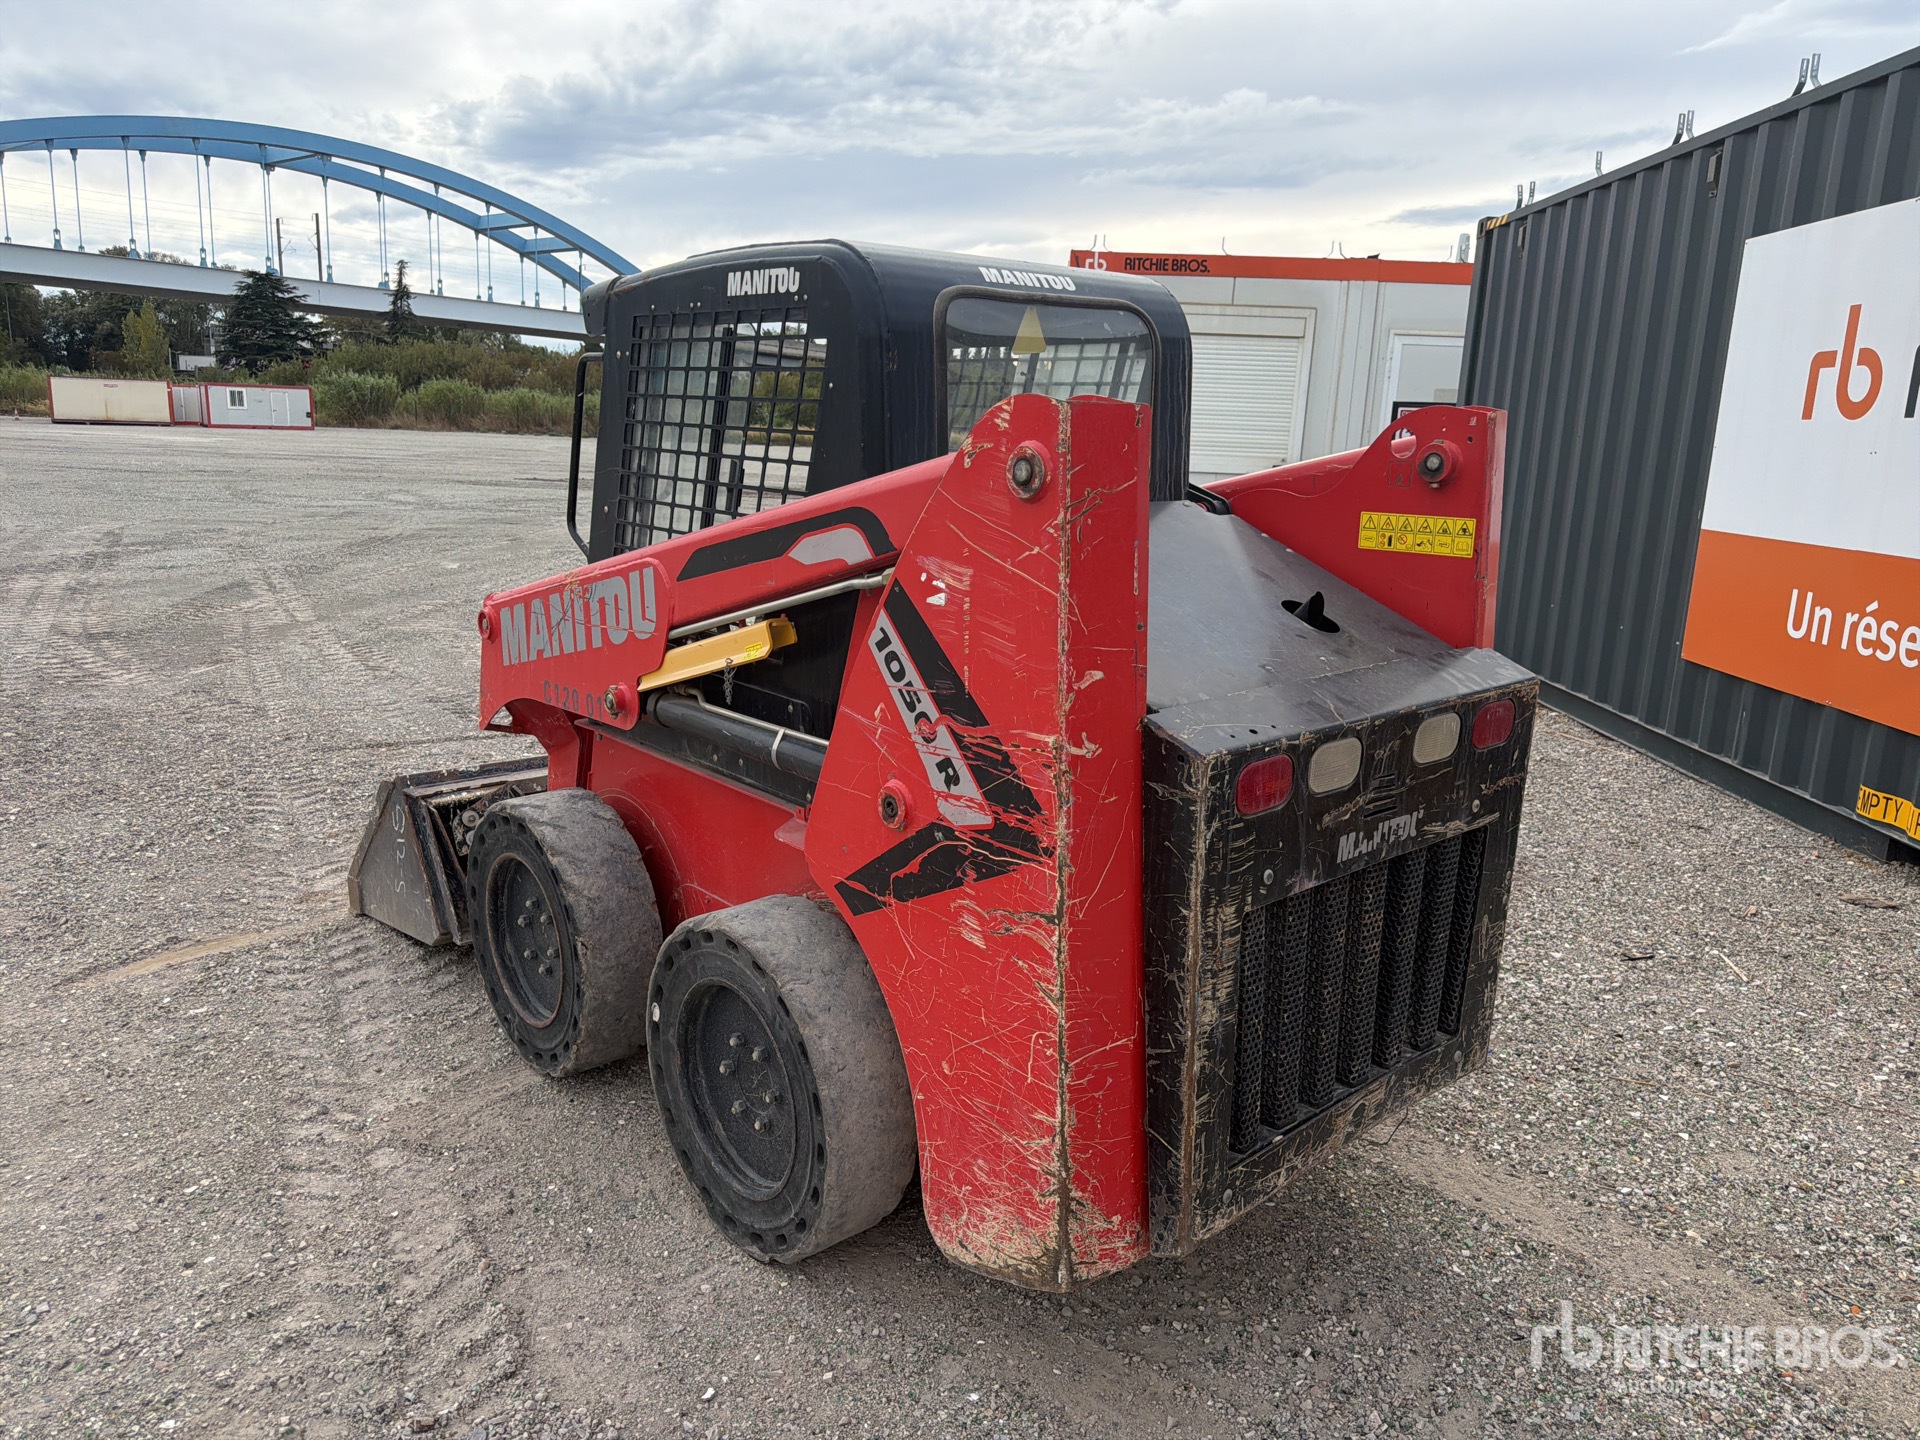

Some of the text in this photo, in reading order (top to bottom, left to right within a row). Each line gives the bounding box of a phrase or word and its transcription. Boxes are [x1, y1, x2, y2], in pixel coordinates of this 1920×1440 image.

[727, 267, 800, 296] MANITOU
[978, 267, 1076, 291] MANITOU
[1124, 258, 1169, 271] RITCHIE
[1172, 259, 1210, 273] BROS.
[1801, 304, 1883, 420] rb
[501, 567, 657, 666] MANITOU
[1787, 589, 1832, 645] Un
[543, 680, 580, 712] C120
